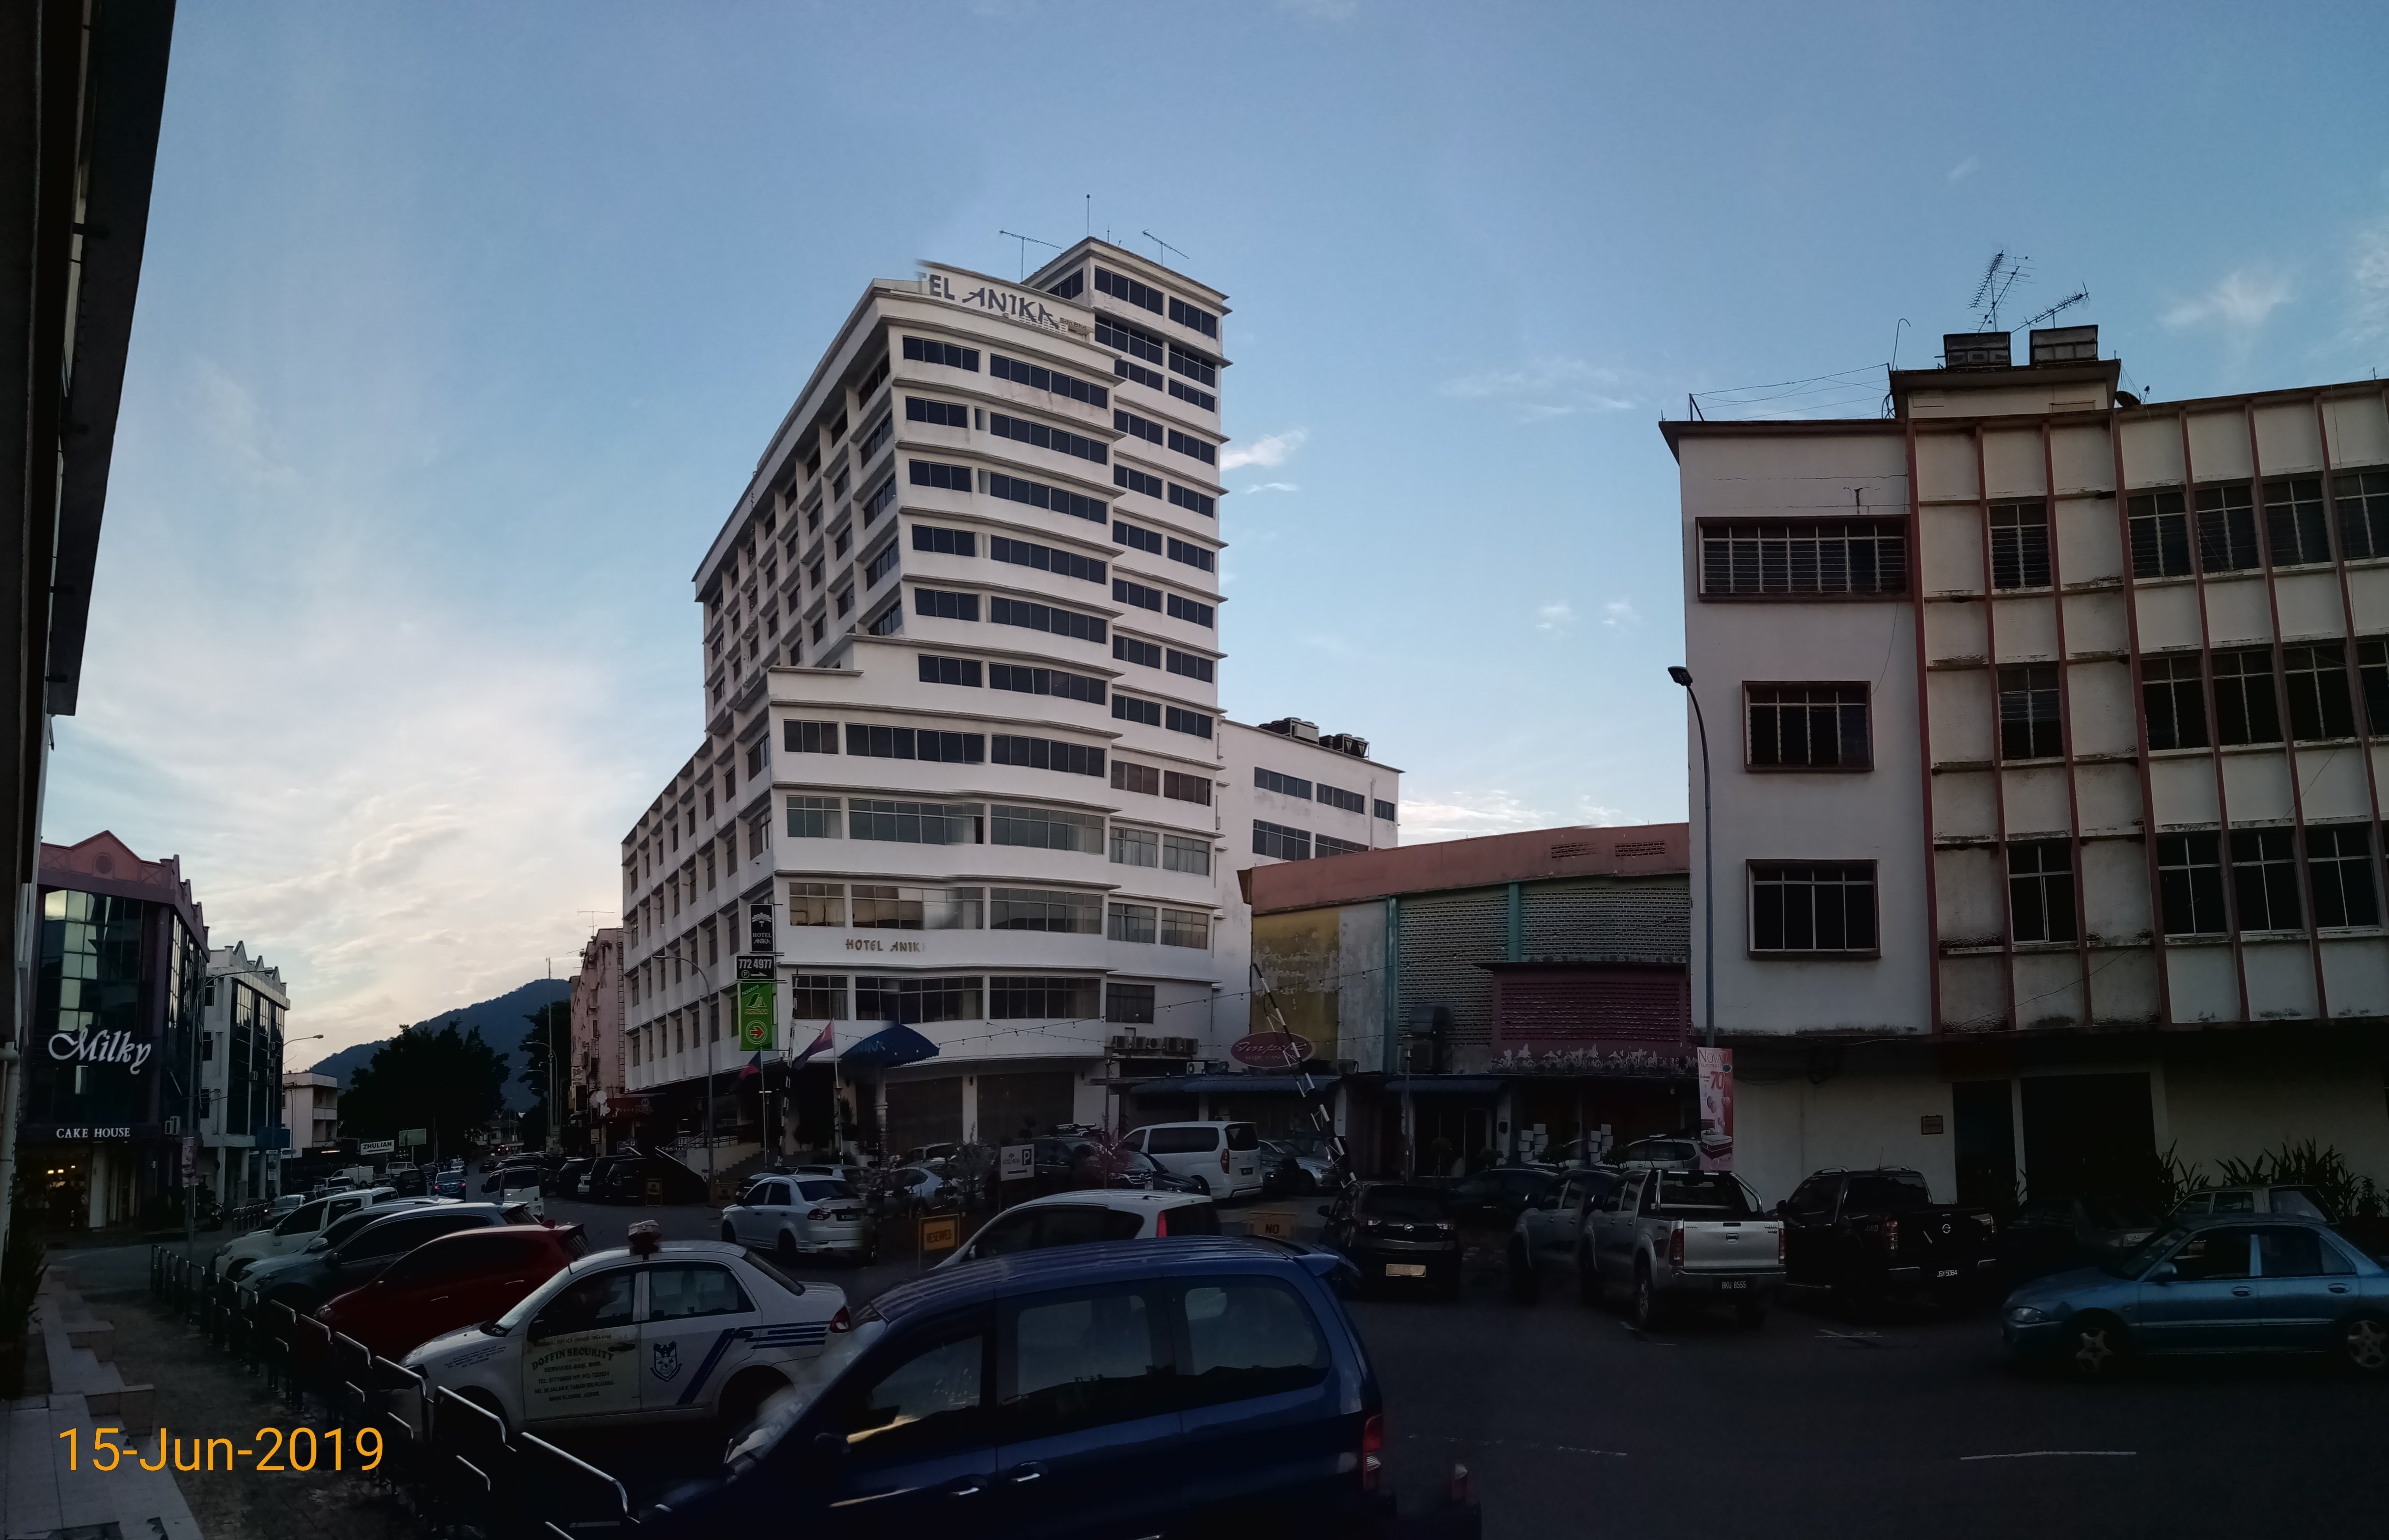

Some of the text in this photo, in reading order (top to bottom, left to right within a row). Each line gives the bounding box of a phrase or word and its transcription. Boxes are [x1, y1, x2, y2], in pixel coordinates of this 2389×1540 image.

[962, 287, 1061, 330] ANIKA
[845, 938, 884, 951] HOTEL
[738, 959, 772, 969] 772 4977
[48, 1027, 152, 1075] Milky
[56, 1128, 131, 1138] CAKE HOUSE
[363, 1141, 392, 1150] ZHULIAN
[1023, 1150, 1030, 1165] P
[1265, 1224, 1279, 1234] NO
[1733, 1281, 1747, 1289] 8555
[531, 1347, 614, 1370] DOFFIN SECURITY
[544, 1365, 572, 1373] SERVICES
